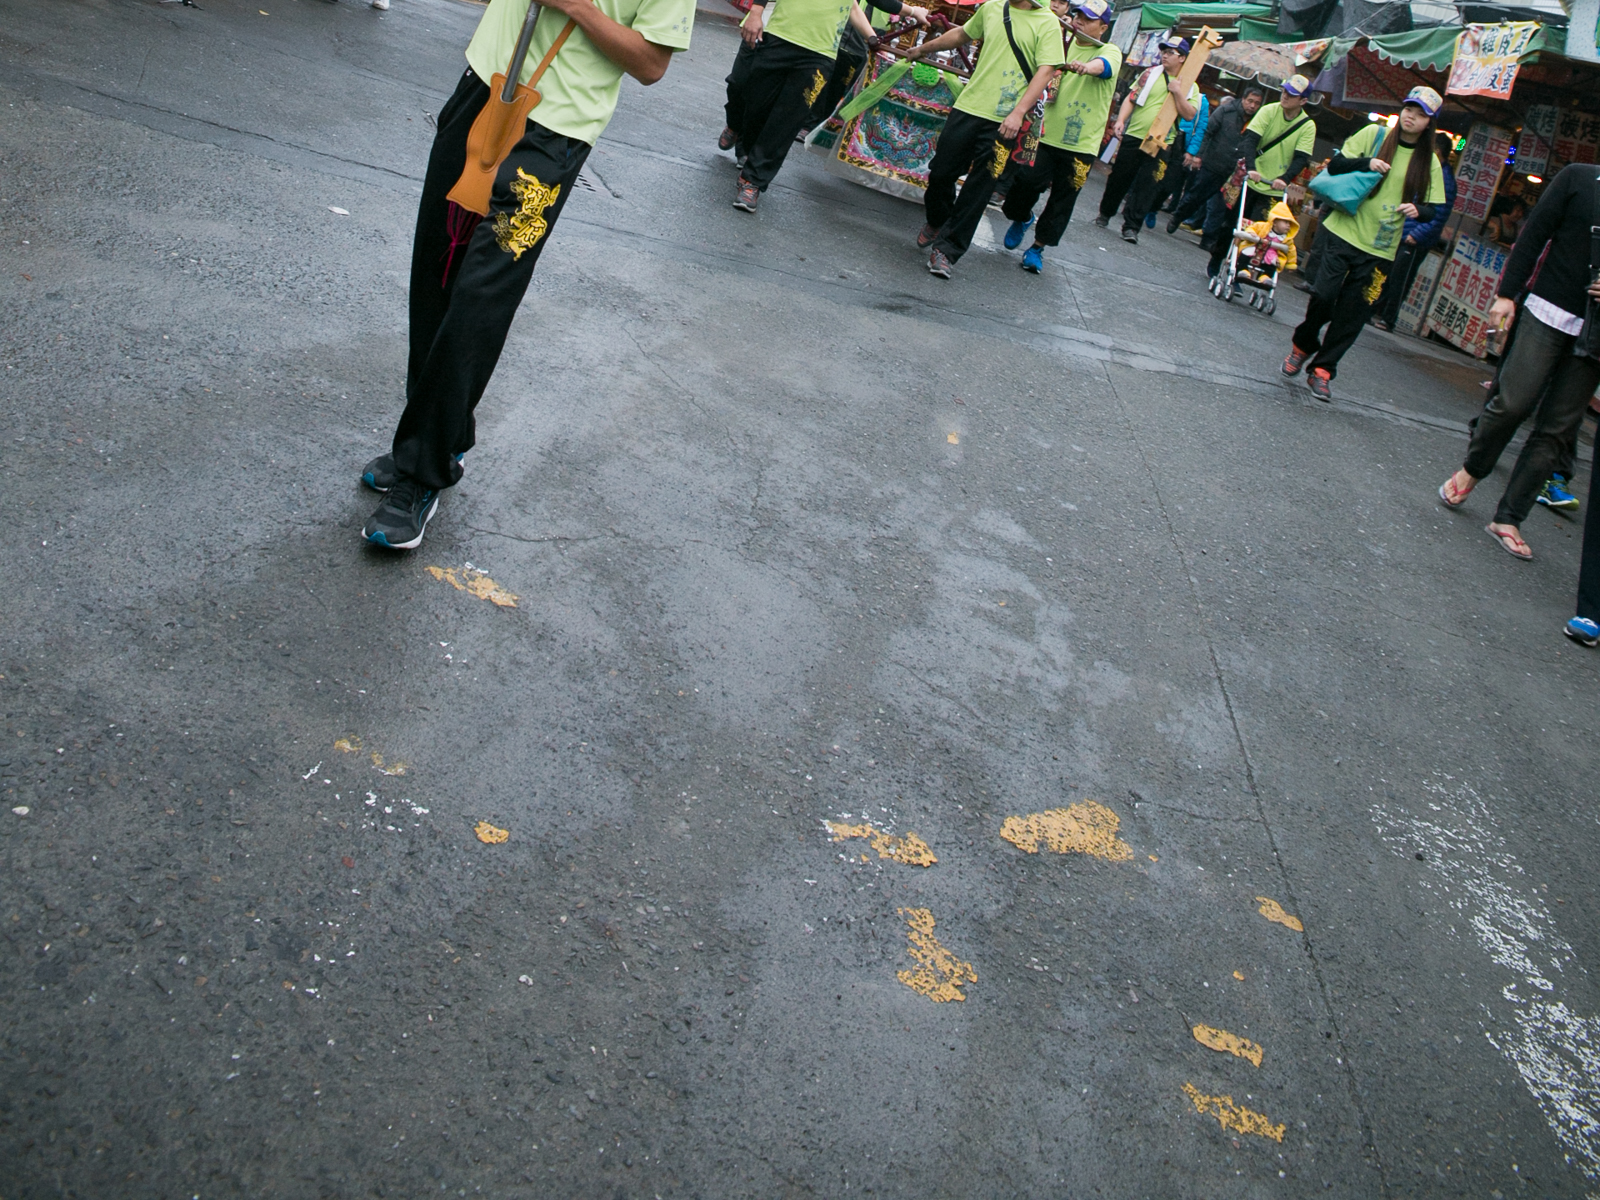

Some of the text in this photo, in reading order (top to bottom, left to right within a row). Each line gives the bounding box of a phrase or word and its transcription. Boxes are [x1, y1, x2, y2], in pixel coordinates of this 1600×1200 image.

[1464, 136, 1510, 219] 正鴨肉香腸
